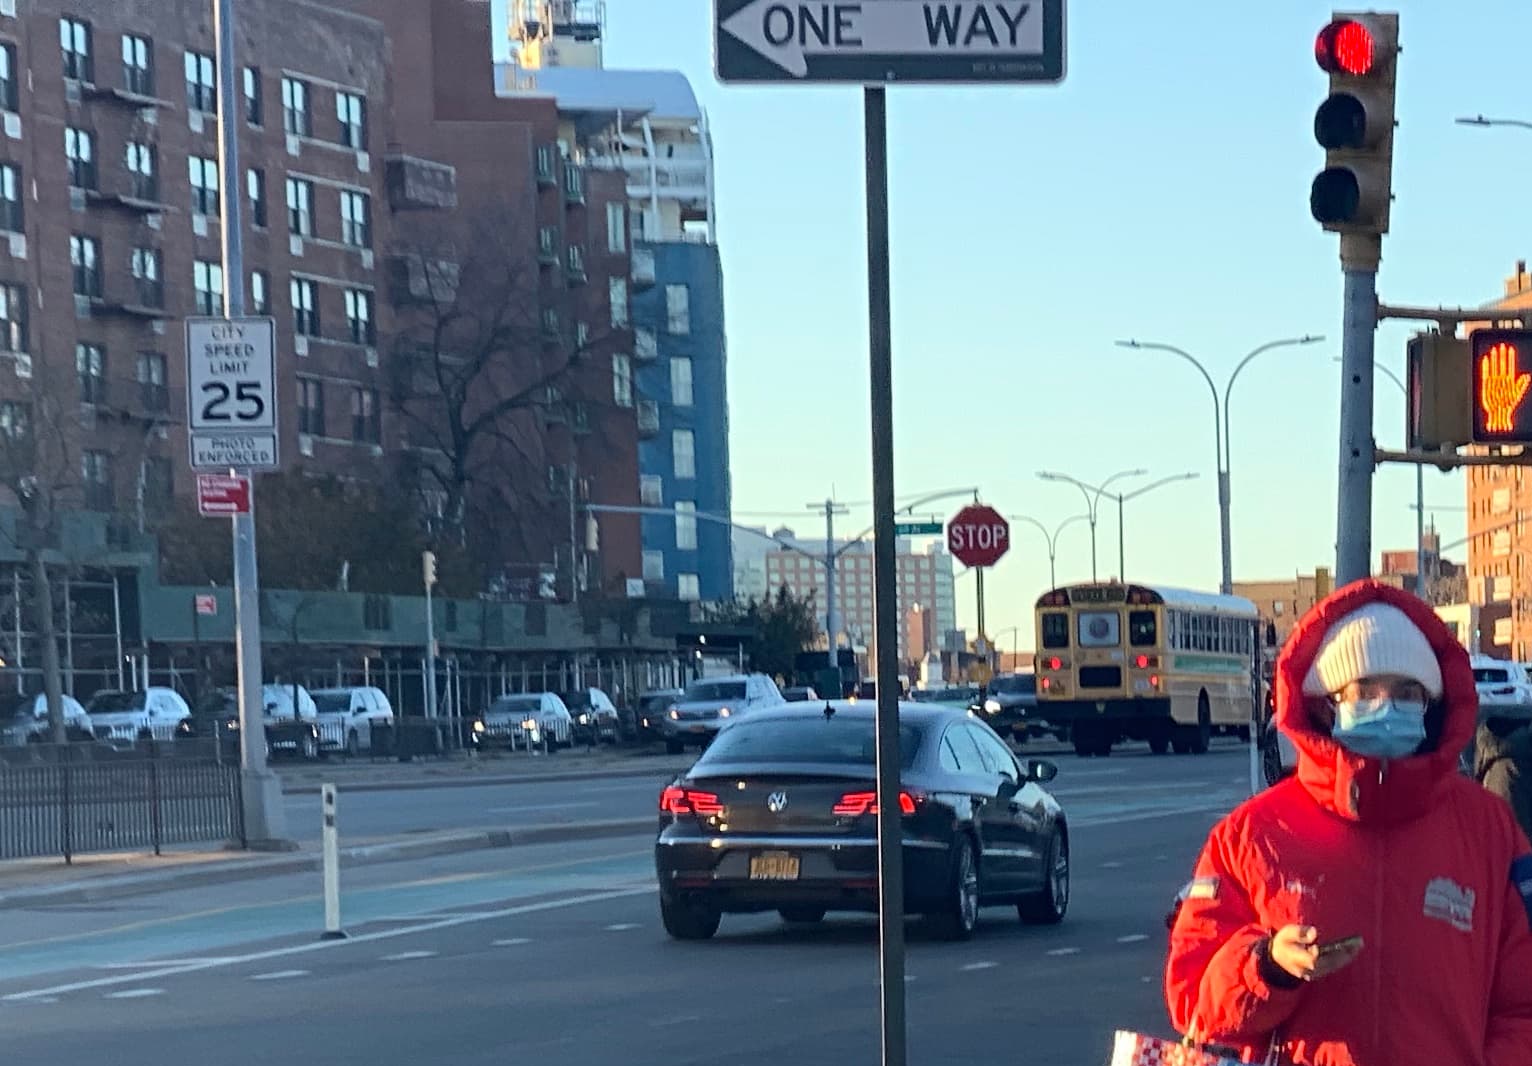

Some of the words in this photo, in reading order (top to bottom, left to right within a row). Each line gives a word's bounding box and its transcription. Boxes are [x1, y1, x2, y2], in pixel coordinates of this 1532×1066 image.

[763, 4, 863, 47] ONE
[923, 3, 1030, 47] WAY
[211, 326, 245, 339] CITY
[204, 344, 254, 358] SPEED
[210, 362, 249, 375] LIMIT
[201, 381, 264, 420] 25
[211, 437, 255, 450] PHOTO
[199, 450, 270, 463] ENFORCED
[951, 524, 1006, 550] STOP
